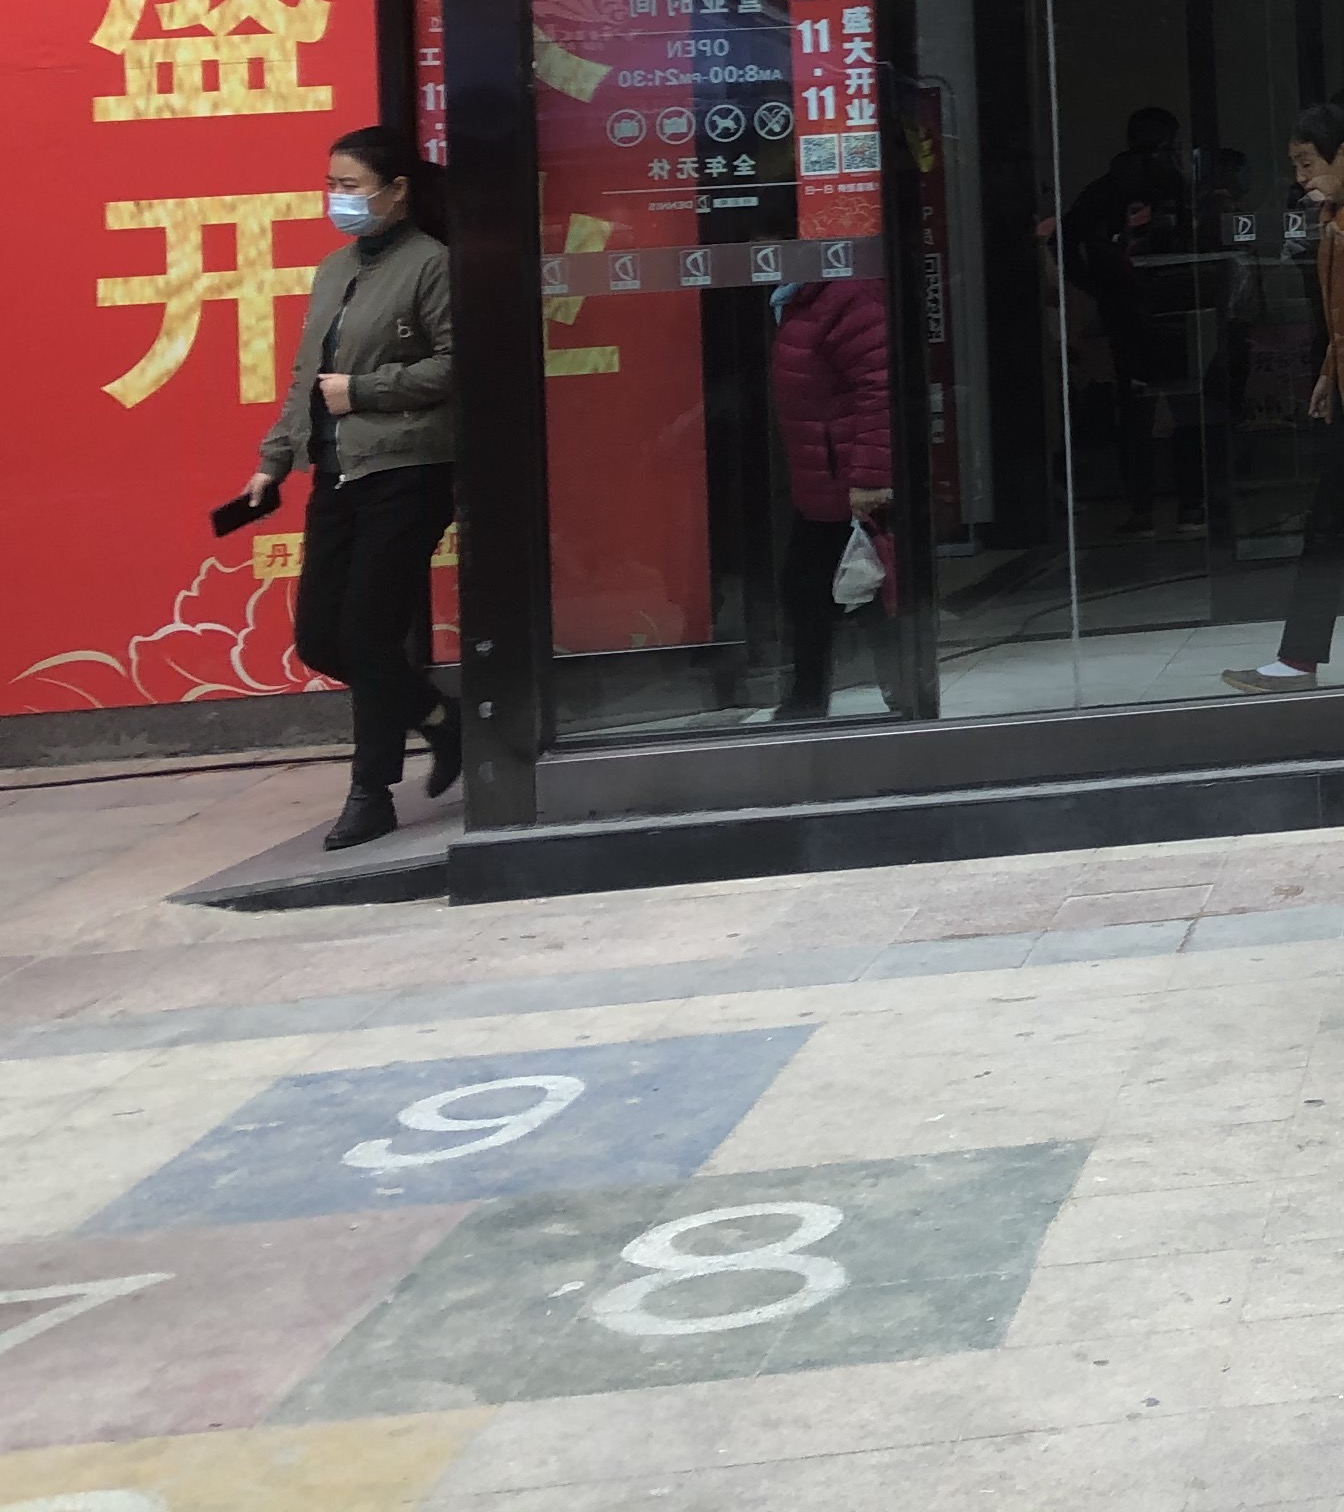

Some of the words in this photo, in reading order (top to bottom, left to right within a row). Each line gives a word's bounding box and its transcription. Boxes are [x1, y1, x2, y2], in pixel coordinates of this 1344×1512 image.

[842, 5, 878, 126] 盛大开业
[594, 1200, 848, 1336] 8
